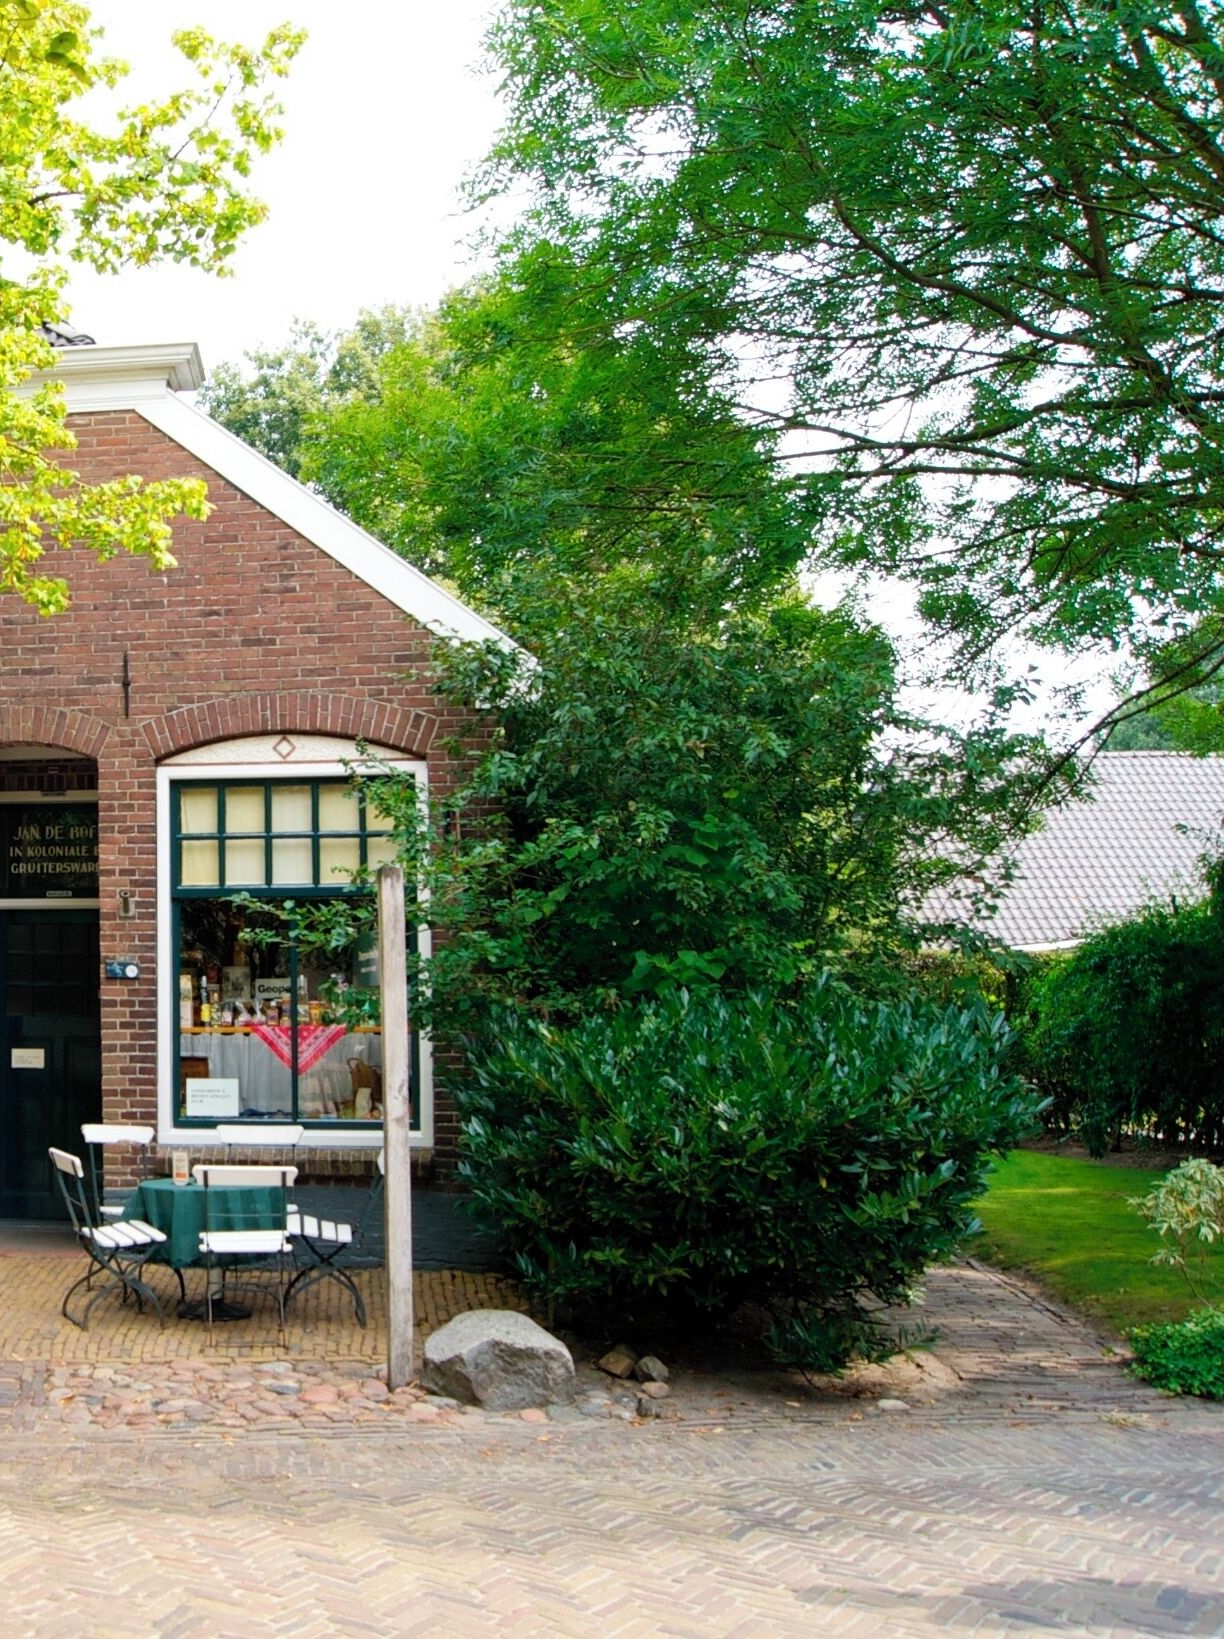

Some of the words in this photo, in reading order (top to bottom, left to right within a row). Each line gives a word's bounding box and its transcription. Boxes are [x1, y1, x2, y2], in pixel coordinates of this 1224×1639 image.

[12, 825, 42, 840] JAN
[45, 825, 65, 840] DE
[9, 846, 24, 857] IN
[27, 845, 89, 857] KOLONIALE
